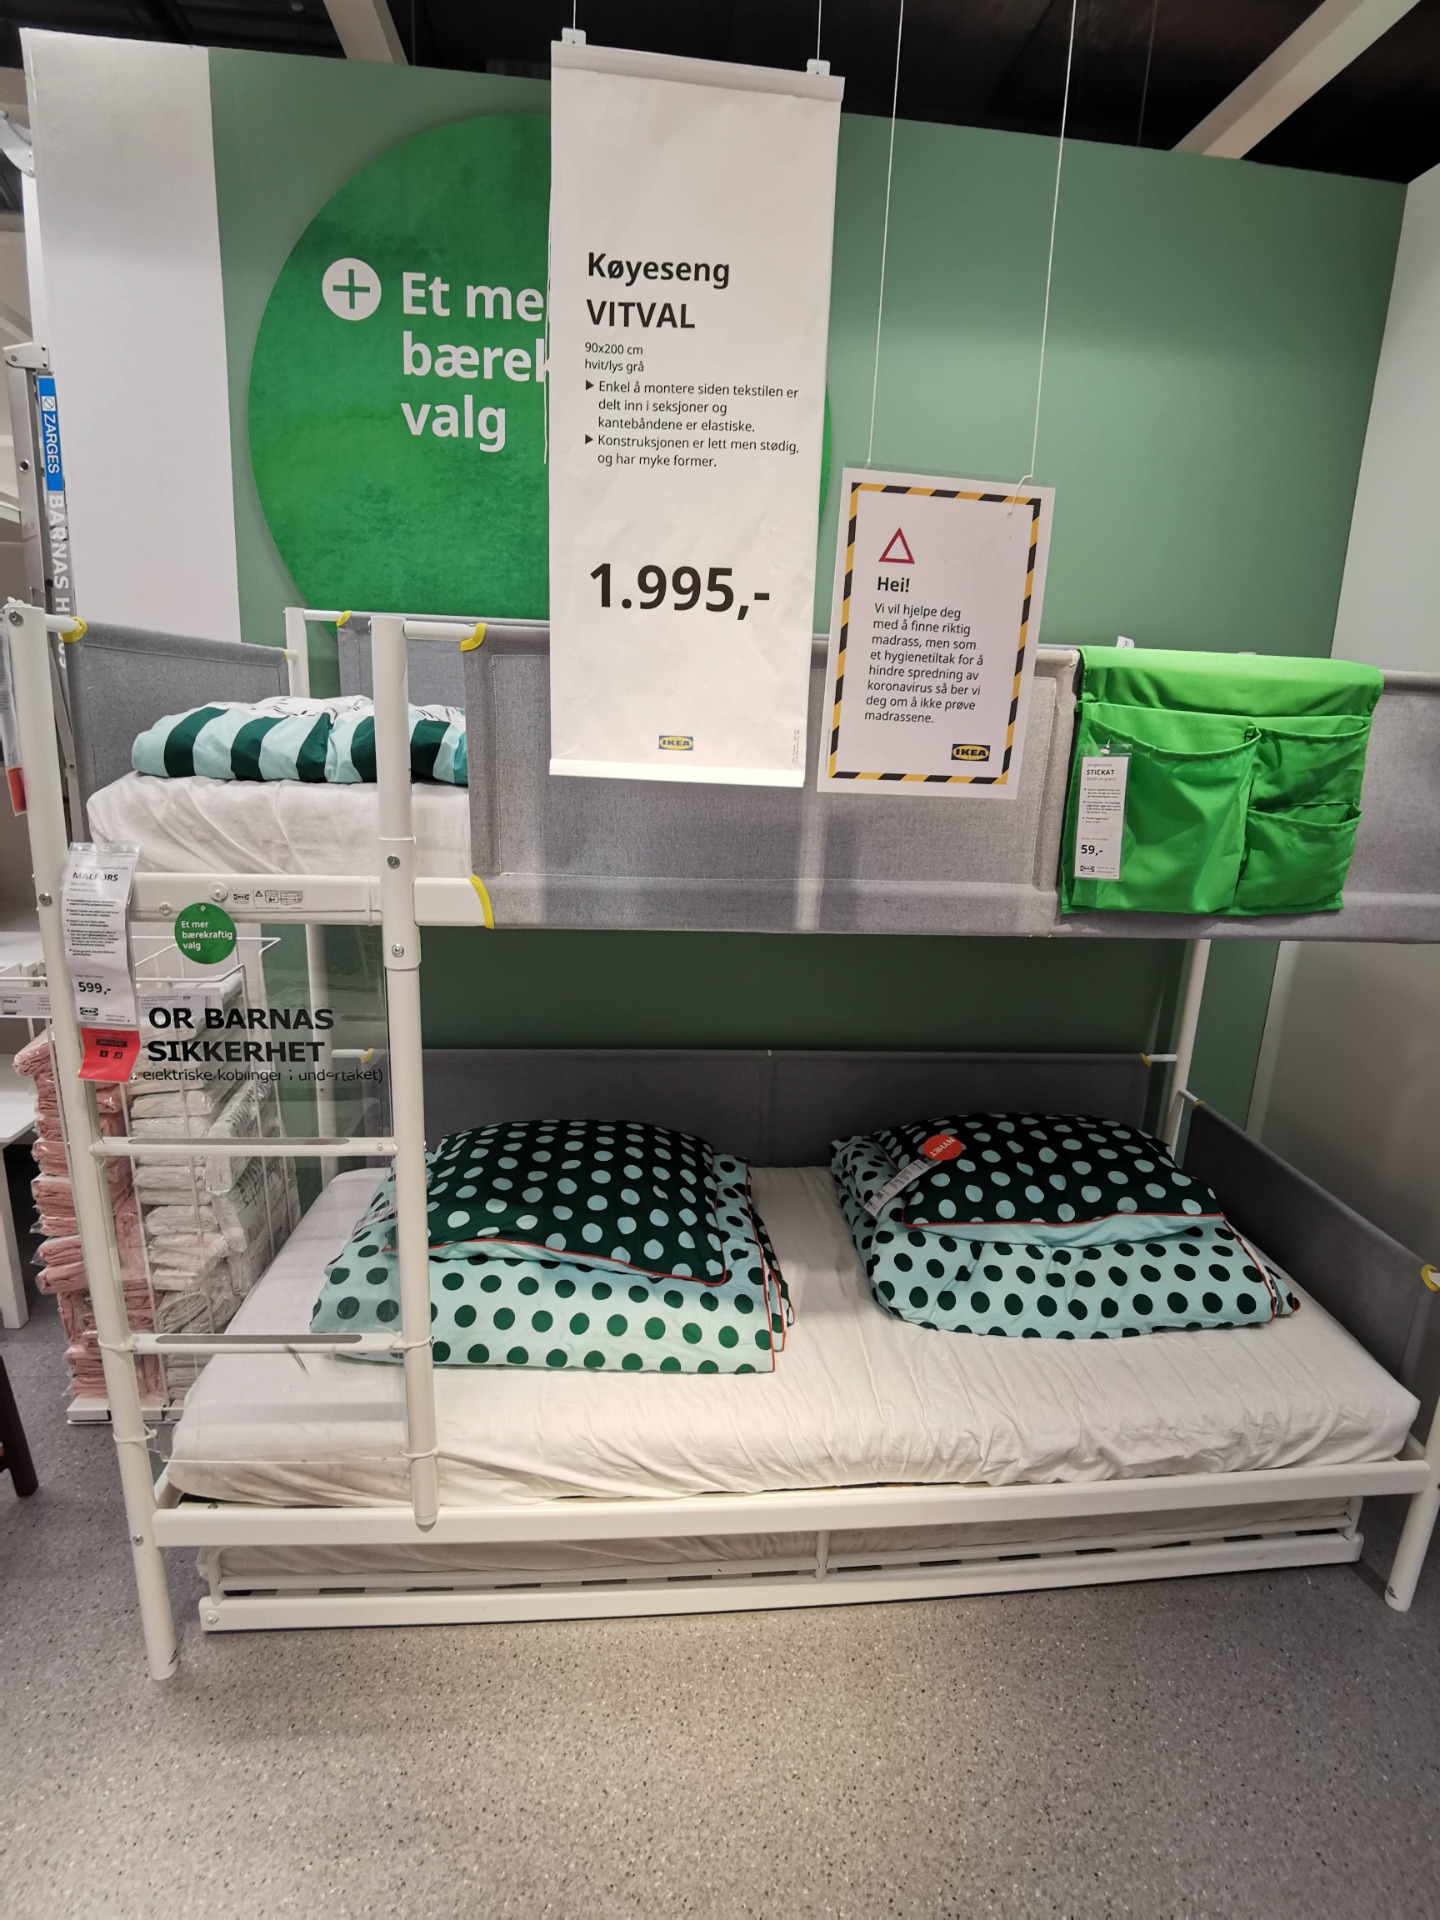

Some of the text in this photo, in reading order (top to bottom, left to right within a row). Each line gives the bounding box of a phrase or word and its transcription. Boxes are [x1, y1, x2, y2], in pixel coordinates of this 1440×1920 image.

[588, 251, 730, 290] Køyeseng
[403, 271, 450, 316] Et
[586, 299, 696, 329] VITVAL
[584, 341, 644, 356] 90x200 cm
[584, 358, 645, 375] hvit/lys grå
[598, 380, 799, 399] Enkel å montere siden tekstilen er
[598, 398, 728, 417] delt inn i seksjoner og
[401, 394, 506, 452] valg
[598, 415, 756, 433] kantebåndene er elastiske.
[43, 413, 60, 474] ZARGES
[597, 435, 800, 455] Konstruksjonen er lett men stødig,
[597, 452, 717, 469] og har myke former.
[49, 494, 69, 590] BARNAS
[590, 563, 770, 621] 1.995,-
[876, 576, 911, 593] Hei!
[874, 602, 962, 621] Vi vil hjelpe deg
[872, 618, 971, 637] med å finne riktig
[871, 634, 977, 651] madrass, men som
[869, 650, 984, 666] et hygienetiltak for å
[868, 665, 980, 683] hindre spredning av
[867, 679, 981, 696] koronavirus så ber vi
[865, 694, 976, 713] deg om å ikke prøve
[864, 710, 935, 724] madrassene.
[661, 738, 691, 748] IKEA
[954, 746, 988, 759] IKEA
[1081, 844, 1103, 856] 59,-
[181, 920, 209, 929] Et mer
[182, 930, 233, 941] bærekraftig
[182, 941, 201, 951] valg
[78, 981, 112, 995] 599,-
[148, 1007, 335, 1030] OR BARNAS
[147, 1040, 325, 1063] SIKKERHET
